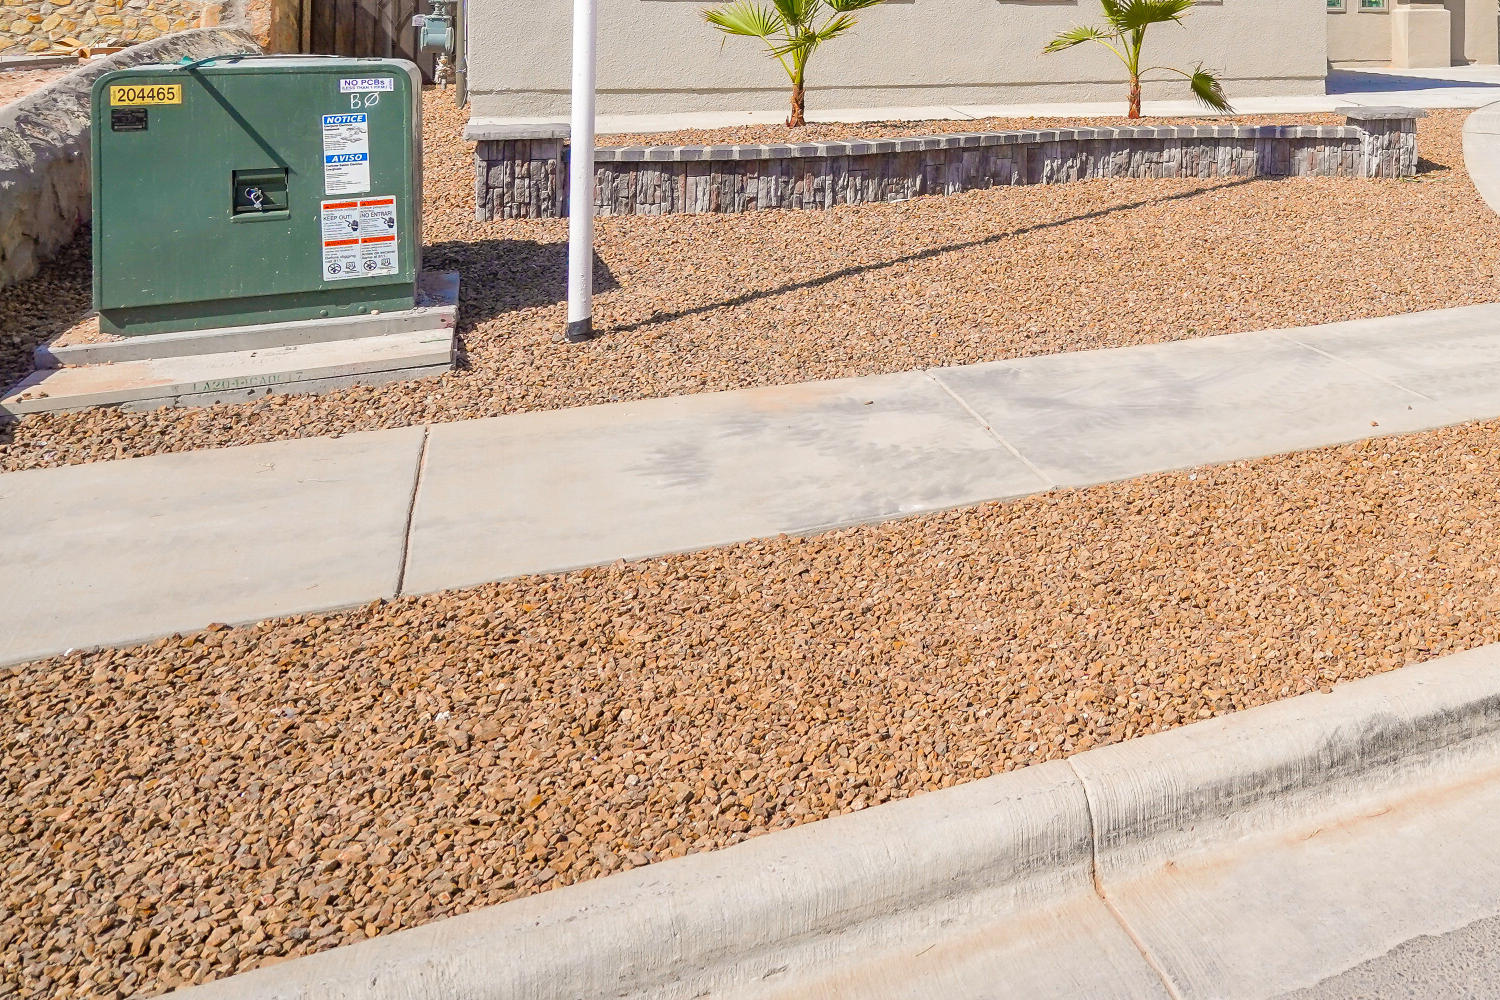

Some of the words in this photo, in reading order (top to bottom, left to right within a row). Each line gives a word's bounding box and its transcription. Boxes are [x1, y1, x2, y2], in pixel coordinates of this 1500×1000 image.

[118, 87, 175, 102] 204465
[326, 115, 363, 124] NOTICE
[331, 154, 363, 163] AVISO
